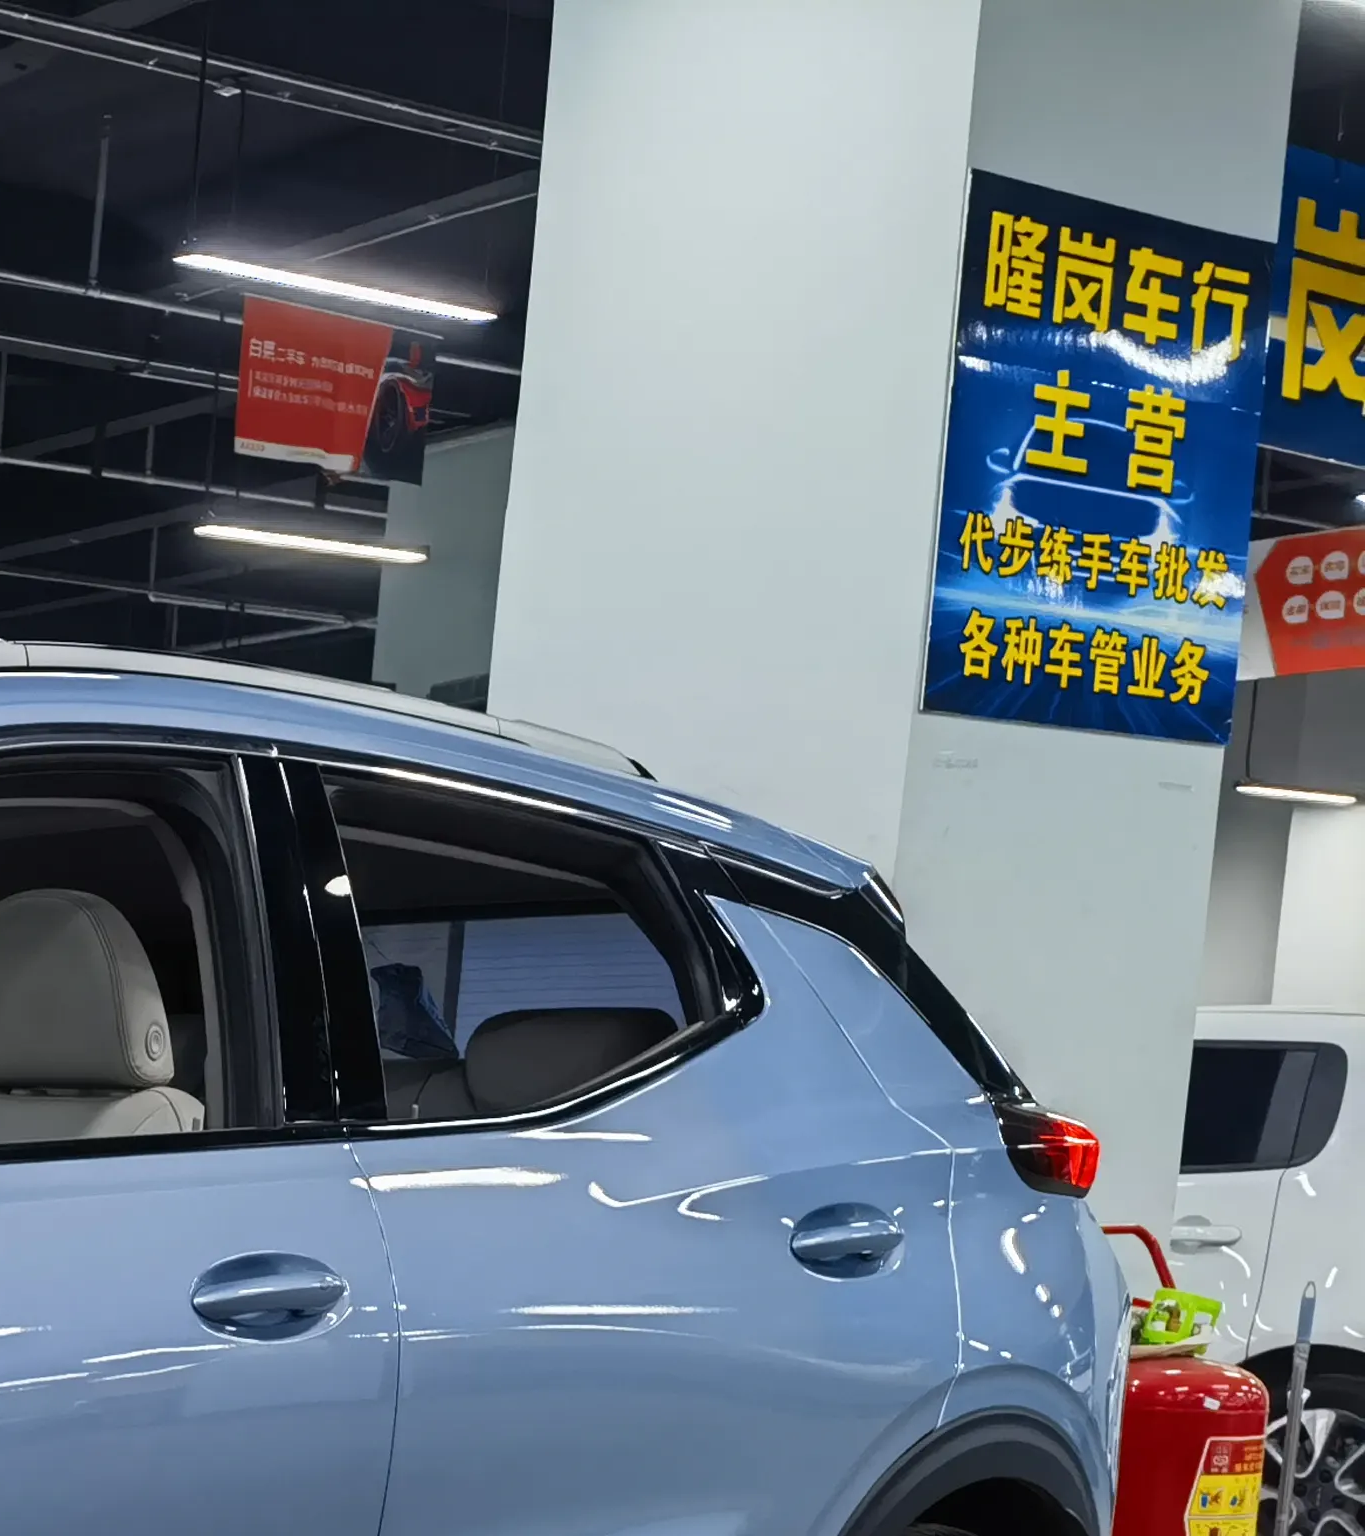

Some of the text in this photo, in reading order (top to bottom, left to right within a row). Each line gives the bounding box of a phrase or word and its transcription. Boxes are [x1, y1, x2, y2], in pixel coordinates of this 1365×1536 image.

[984, 210, 1250, 360] 隆岗车行
[1025, 370, 1186, 493] 主营
[959, 511, 1229, 608] 代步练手车批发
[959, 609, 1209, 704] 各种车管业务
